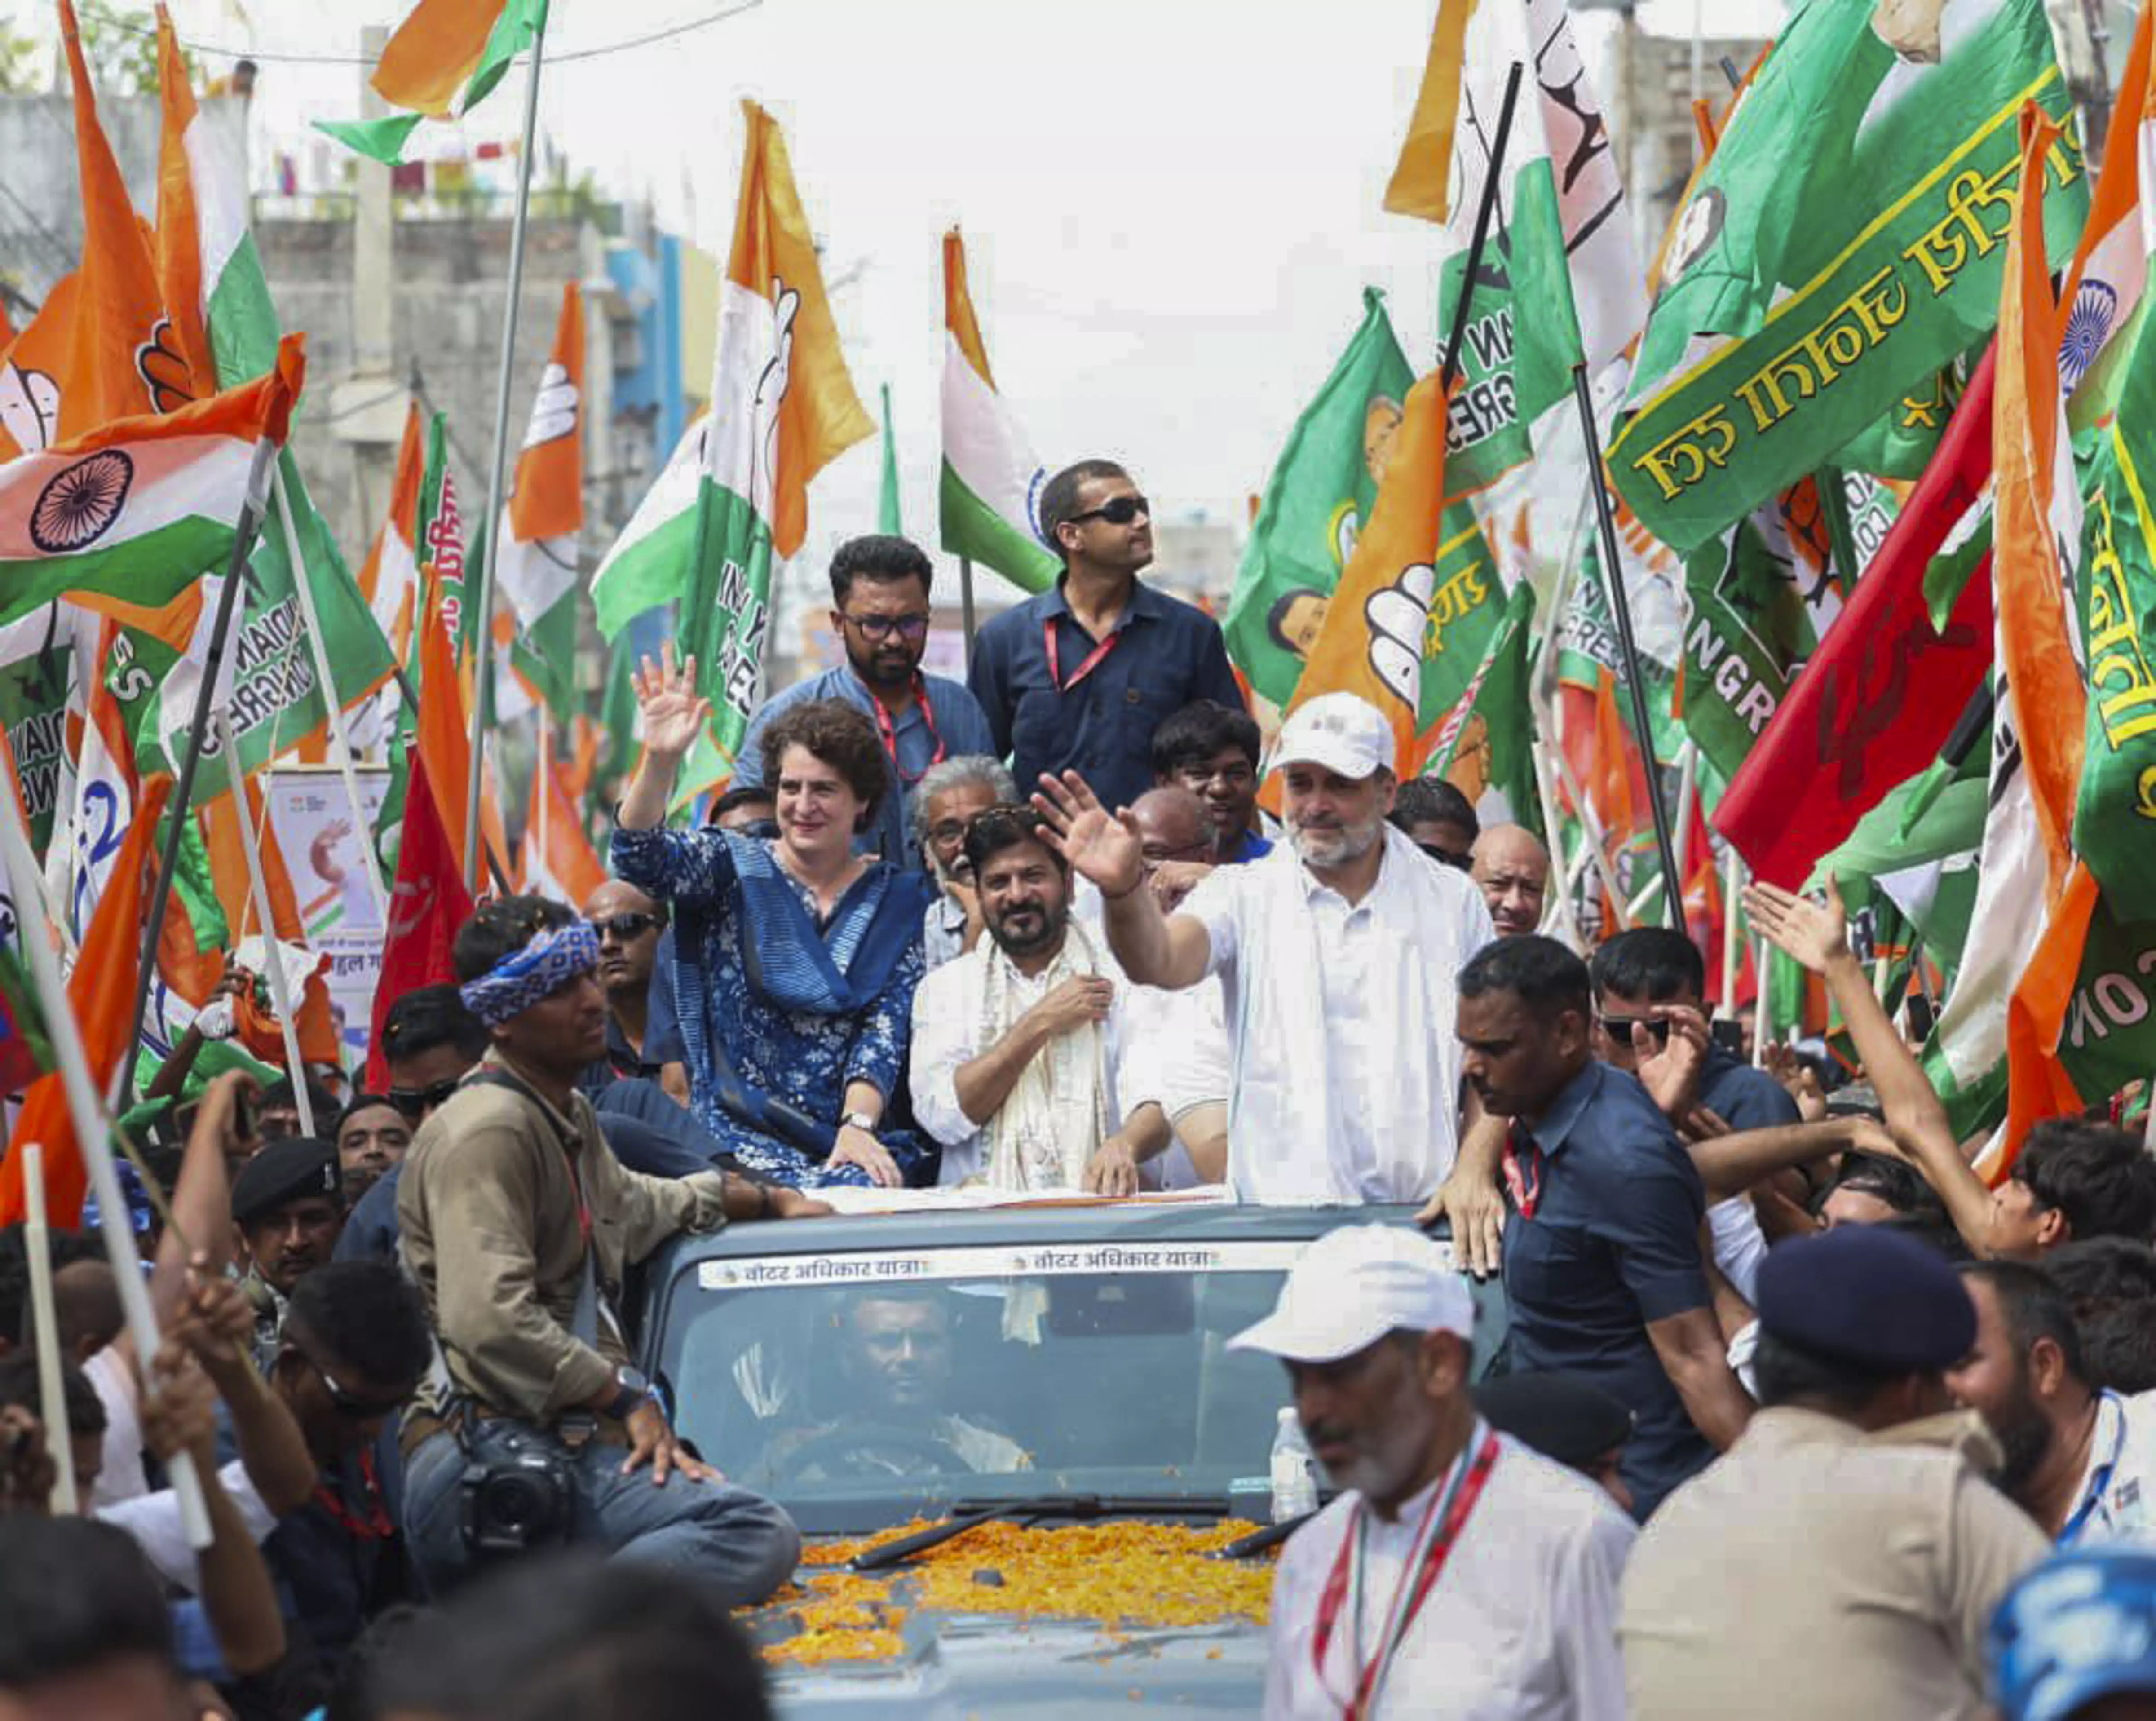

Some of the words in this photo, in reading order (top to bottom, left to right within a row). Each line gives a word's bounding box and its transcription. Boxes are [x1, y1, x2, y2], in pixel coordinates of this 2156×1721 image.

[745, 1262, 791, 1282] वोटर
[795, 1258, 871, 1279] अधिकार
[875, 1260, 919, 1277] यात्रा
[1034, 1250, 1079, 1270] वोटर
[1085, 1248, 1161, 1269] अधिकार
[1165, 1251, 1209, 1268] यात्रा
